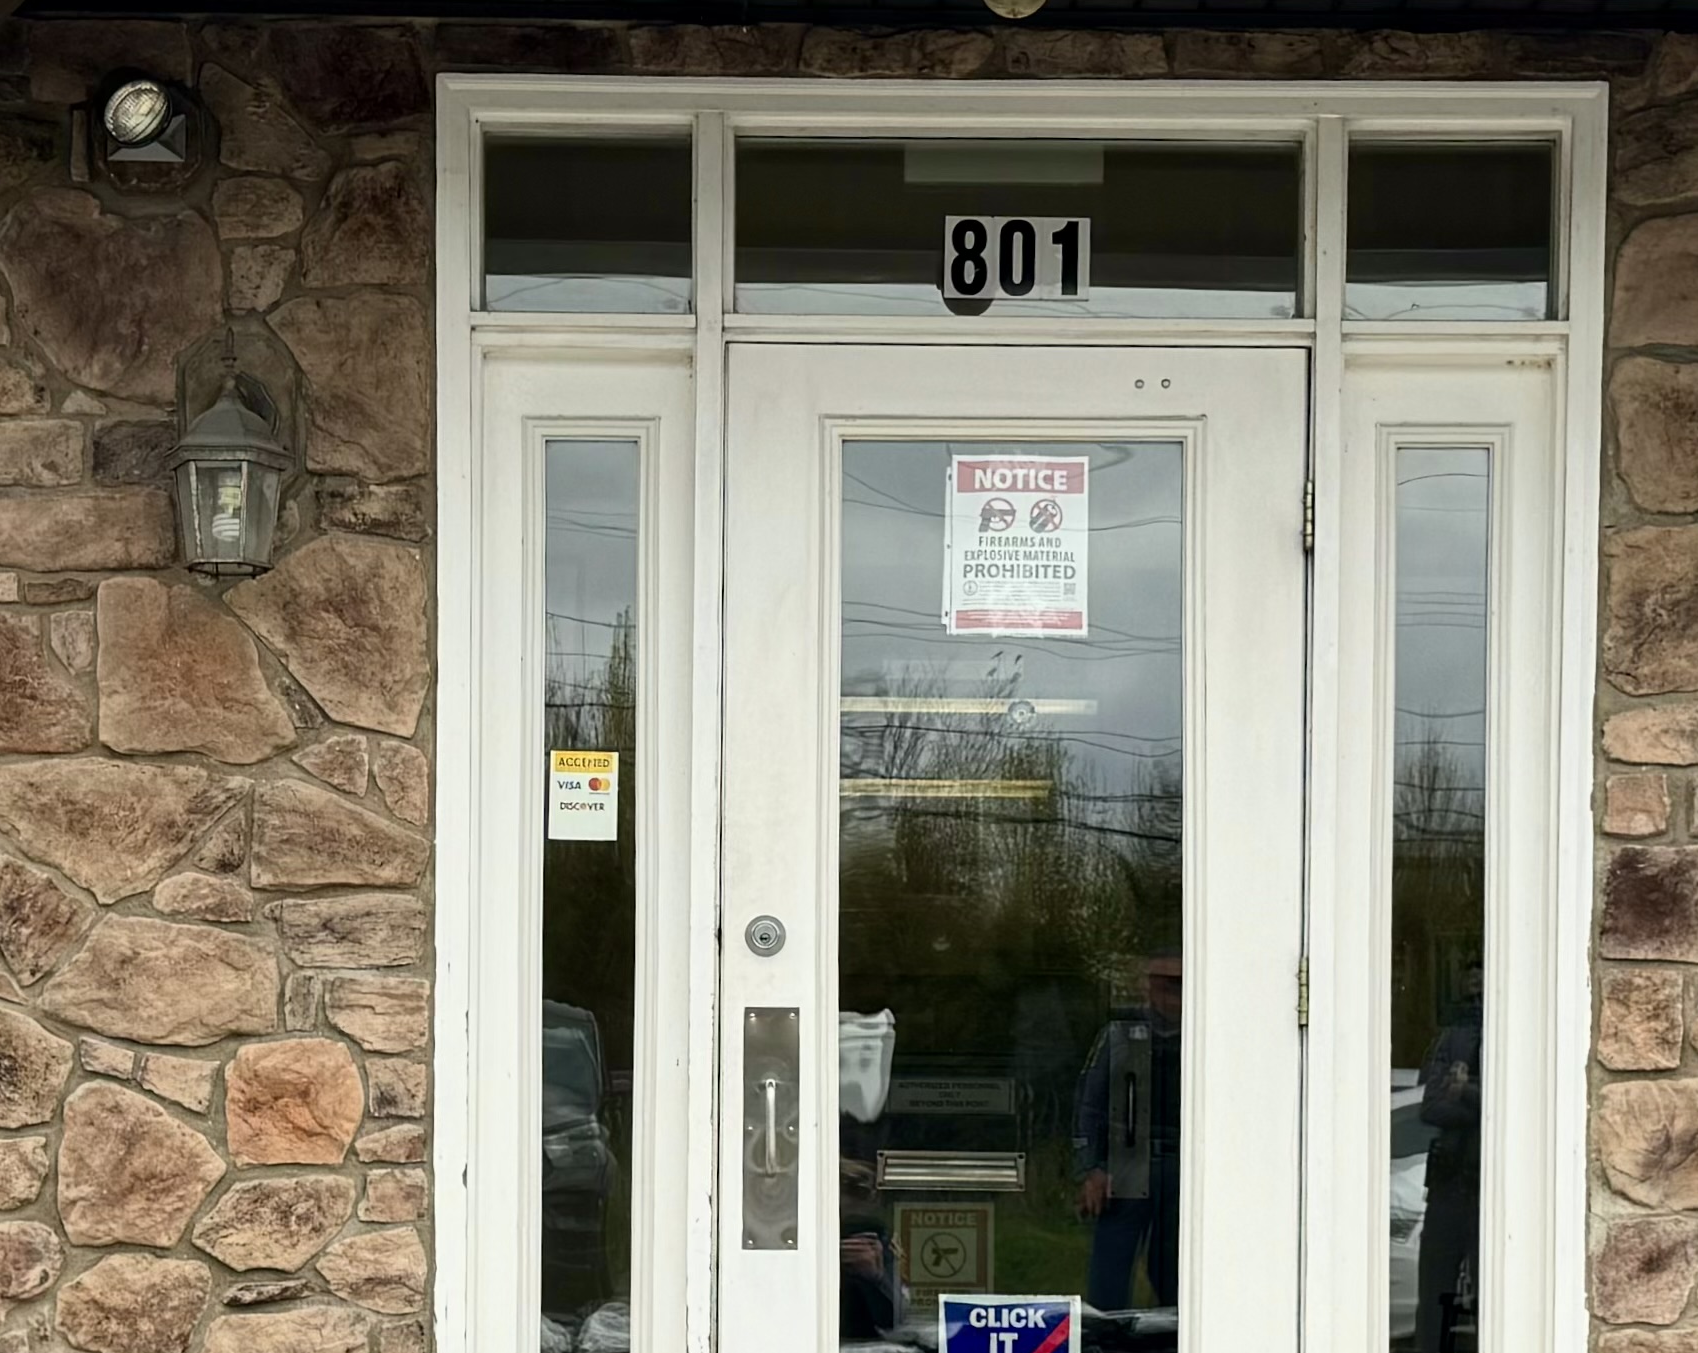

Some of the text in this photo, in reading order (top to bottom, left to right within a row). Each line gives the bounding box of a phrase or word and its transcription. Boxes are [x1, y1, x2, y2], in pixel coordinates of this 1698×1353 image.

[951, 219, 1079, 296] 801
[974, 468, 1067, 491] NOTICE
[979, 536, 1061, 548] FIREARMS AND
[964, 550, 1075, 562] EXPLOSIVE MATERIAL
[963, 563, 1076, 579] PROHIBITED
[557, 781, 581, 790] VISA
[560, 802, 605, 811] DISCOVER
[911, 1212, 977, 1225] NOTICE
[969, 1308, 1046, 1328] CLICK
